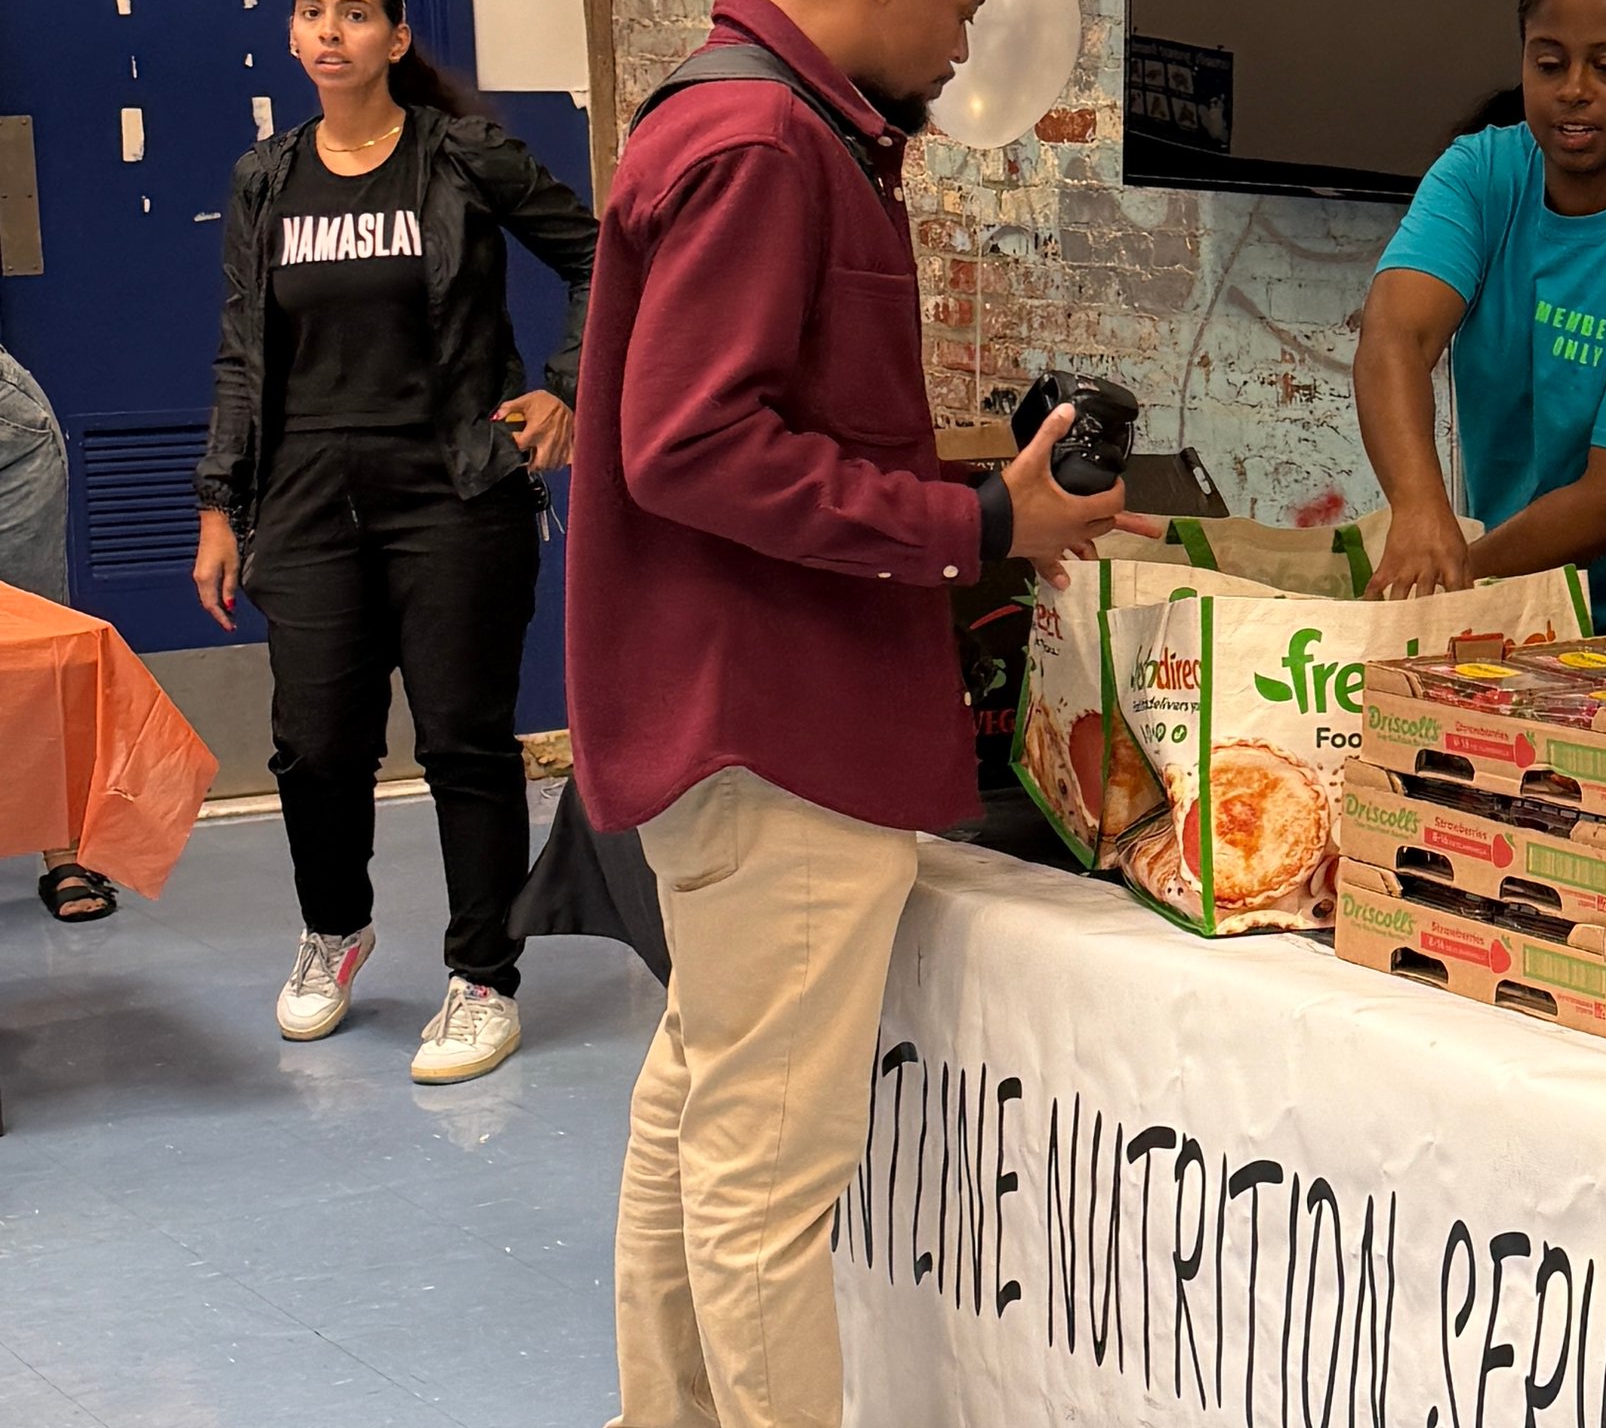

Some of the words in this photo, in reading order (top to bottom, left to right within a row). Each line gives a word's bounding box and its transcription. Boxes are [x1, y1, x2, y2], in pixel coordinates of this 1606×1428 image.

[281, 210, 423, 266] NAMASLAY
[1552, 336, 1603, 367] ONLY
[1368, 705, 1441, 741] Driscoll's
[1346, 793, 1420, 834] Driscoll's
[1342, 893, 1417, 936] Driscoll's
